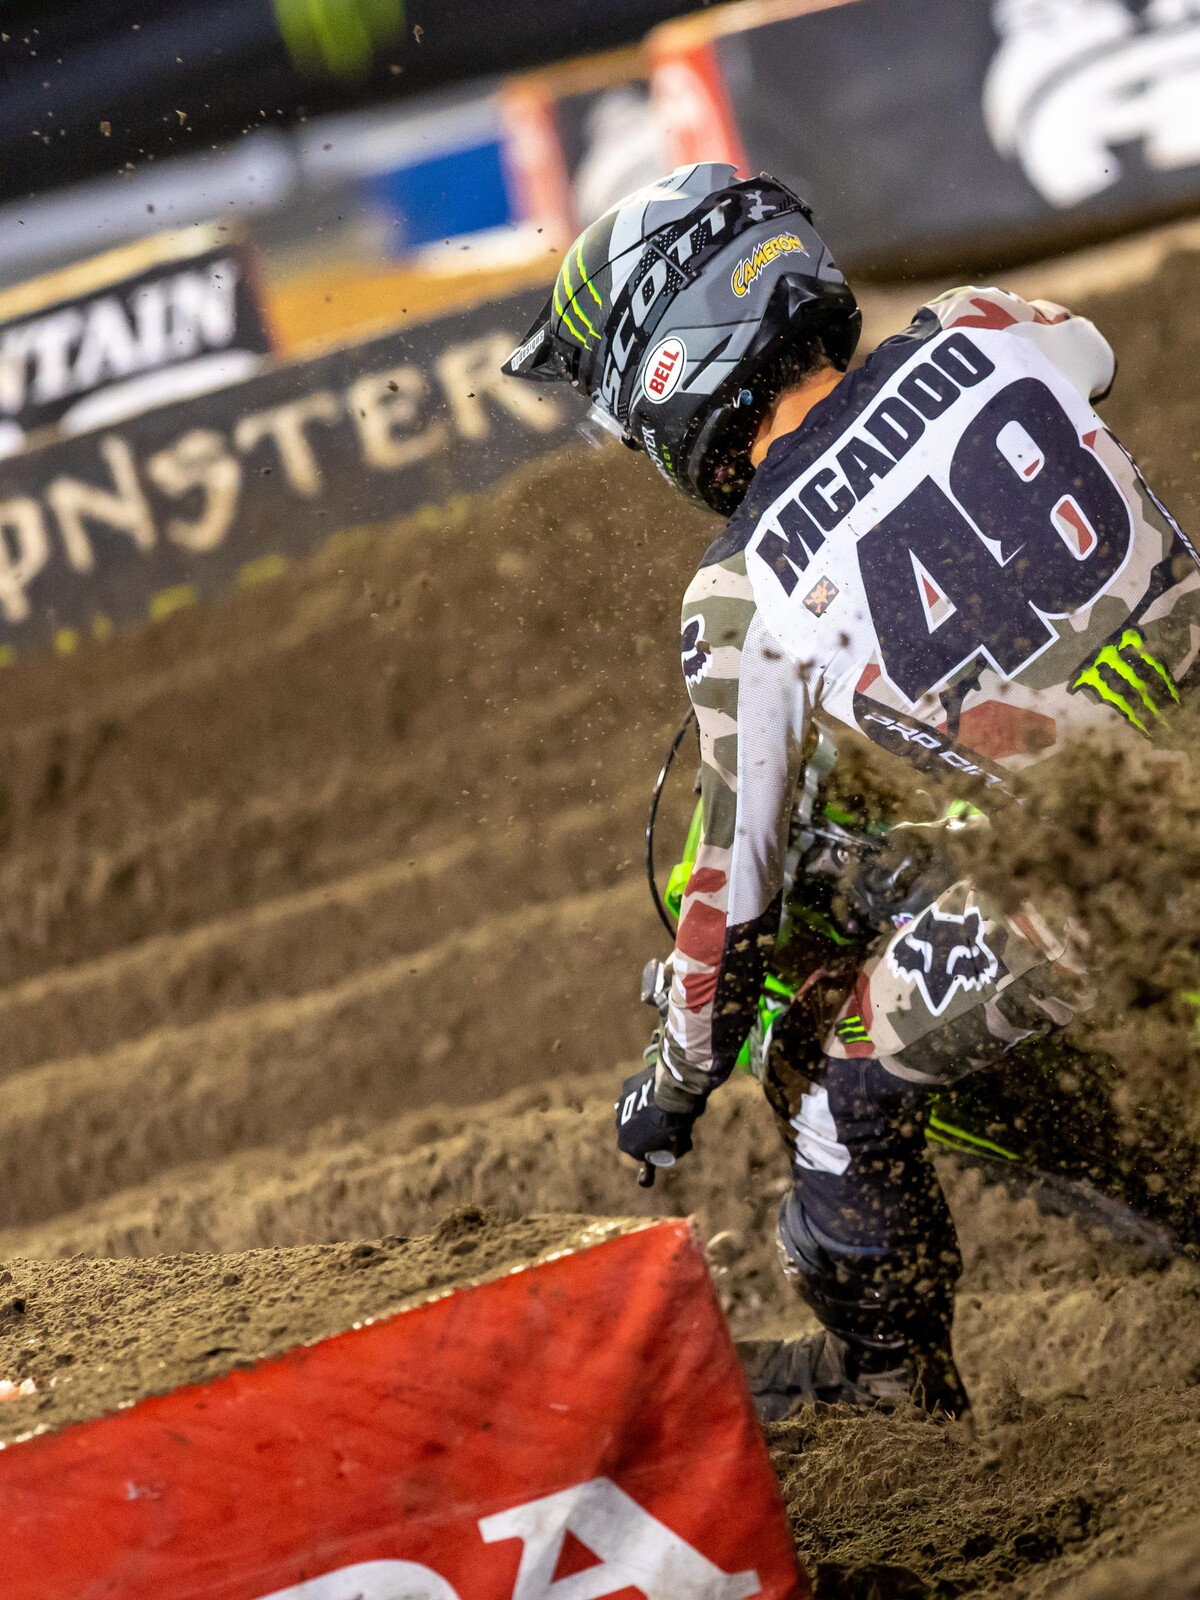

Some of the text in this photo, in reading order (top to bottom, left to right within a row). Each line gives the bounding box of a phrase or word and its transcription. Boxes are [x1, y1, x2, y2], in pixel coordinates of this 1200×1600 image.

[731, 232, 808, 298] CAMERON
[601, 199, 732, 418] SCOTT
[649, 349, 680, 395] BELL
[755, 332, 996, 597] MCADOO
[855, 376, 1132, 707] 48
[863, 712, 942, 750] PRO
[614, 1079, 653, 1126] OX
